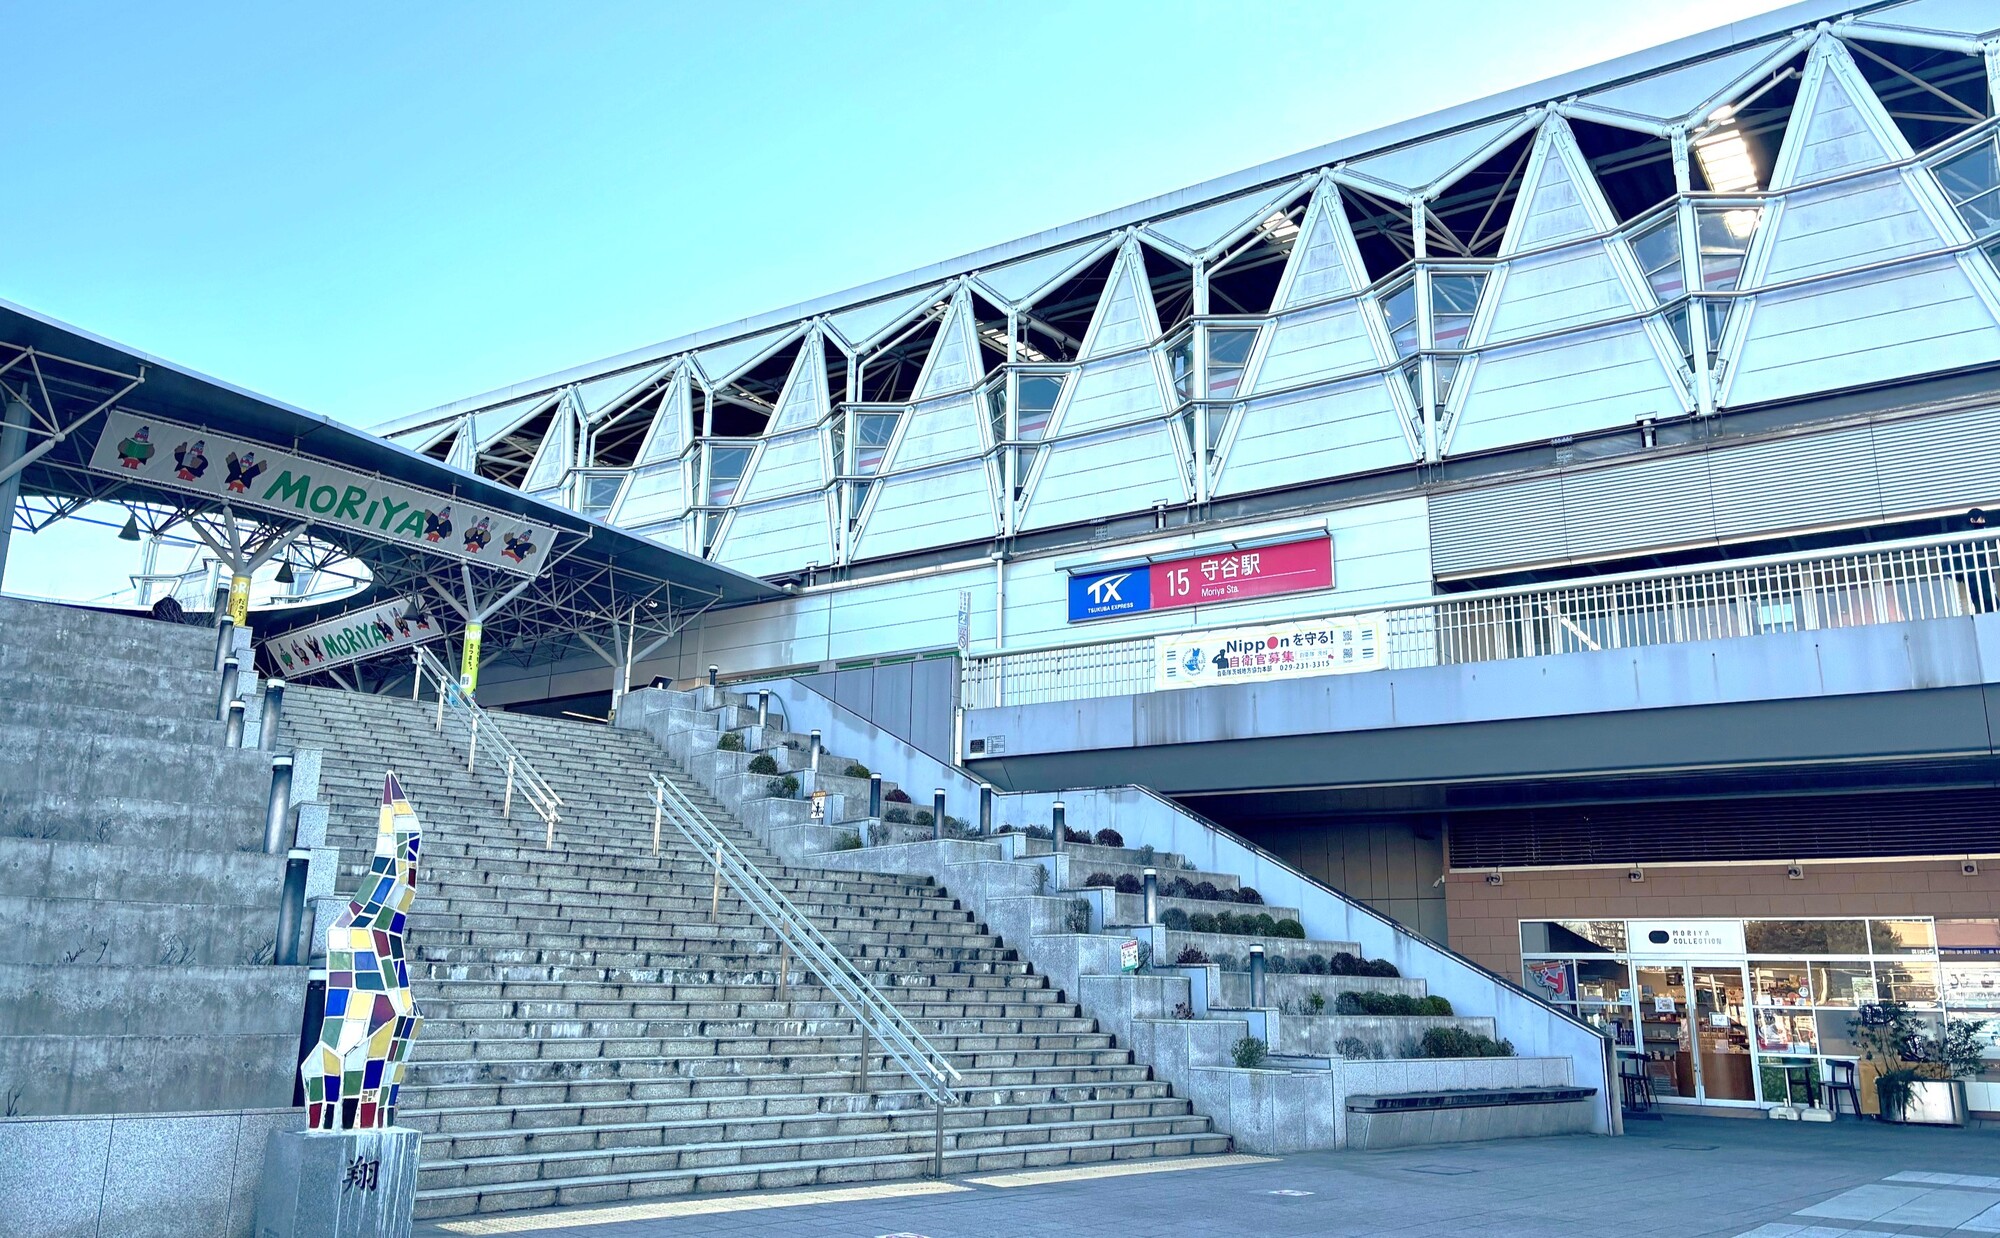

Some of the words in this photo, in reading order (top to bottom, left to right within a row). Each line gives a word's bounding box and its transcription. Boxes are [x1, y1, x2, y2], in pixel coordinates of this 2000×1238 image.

[262, 470, 426, 539] MORIYA
[1200, 553, 1260, 581] 守谷駅
[1087, 572, 1132, 604] TX
[1166, 568, 1190, 597] 15
[1201, 586, 1225, 597] Moriya
[1226, 584, 1239, 594] Sta.
[1088, 606, 1110, 614] TSUKUBA
[1111, 602, 1134, 611] EXPRESS
[321, 622, 387, 659] MORIYA
[1230, 650, 1295, 668] 自衛官募集
[342, 1155, 379, 1194] 翔
